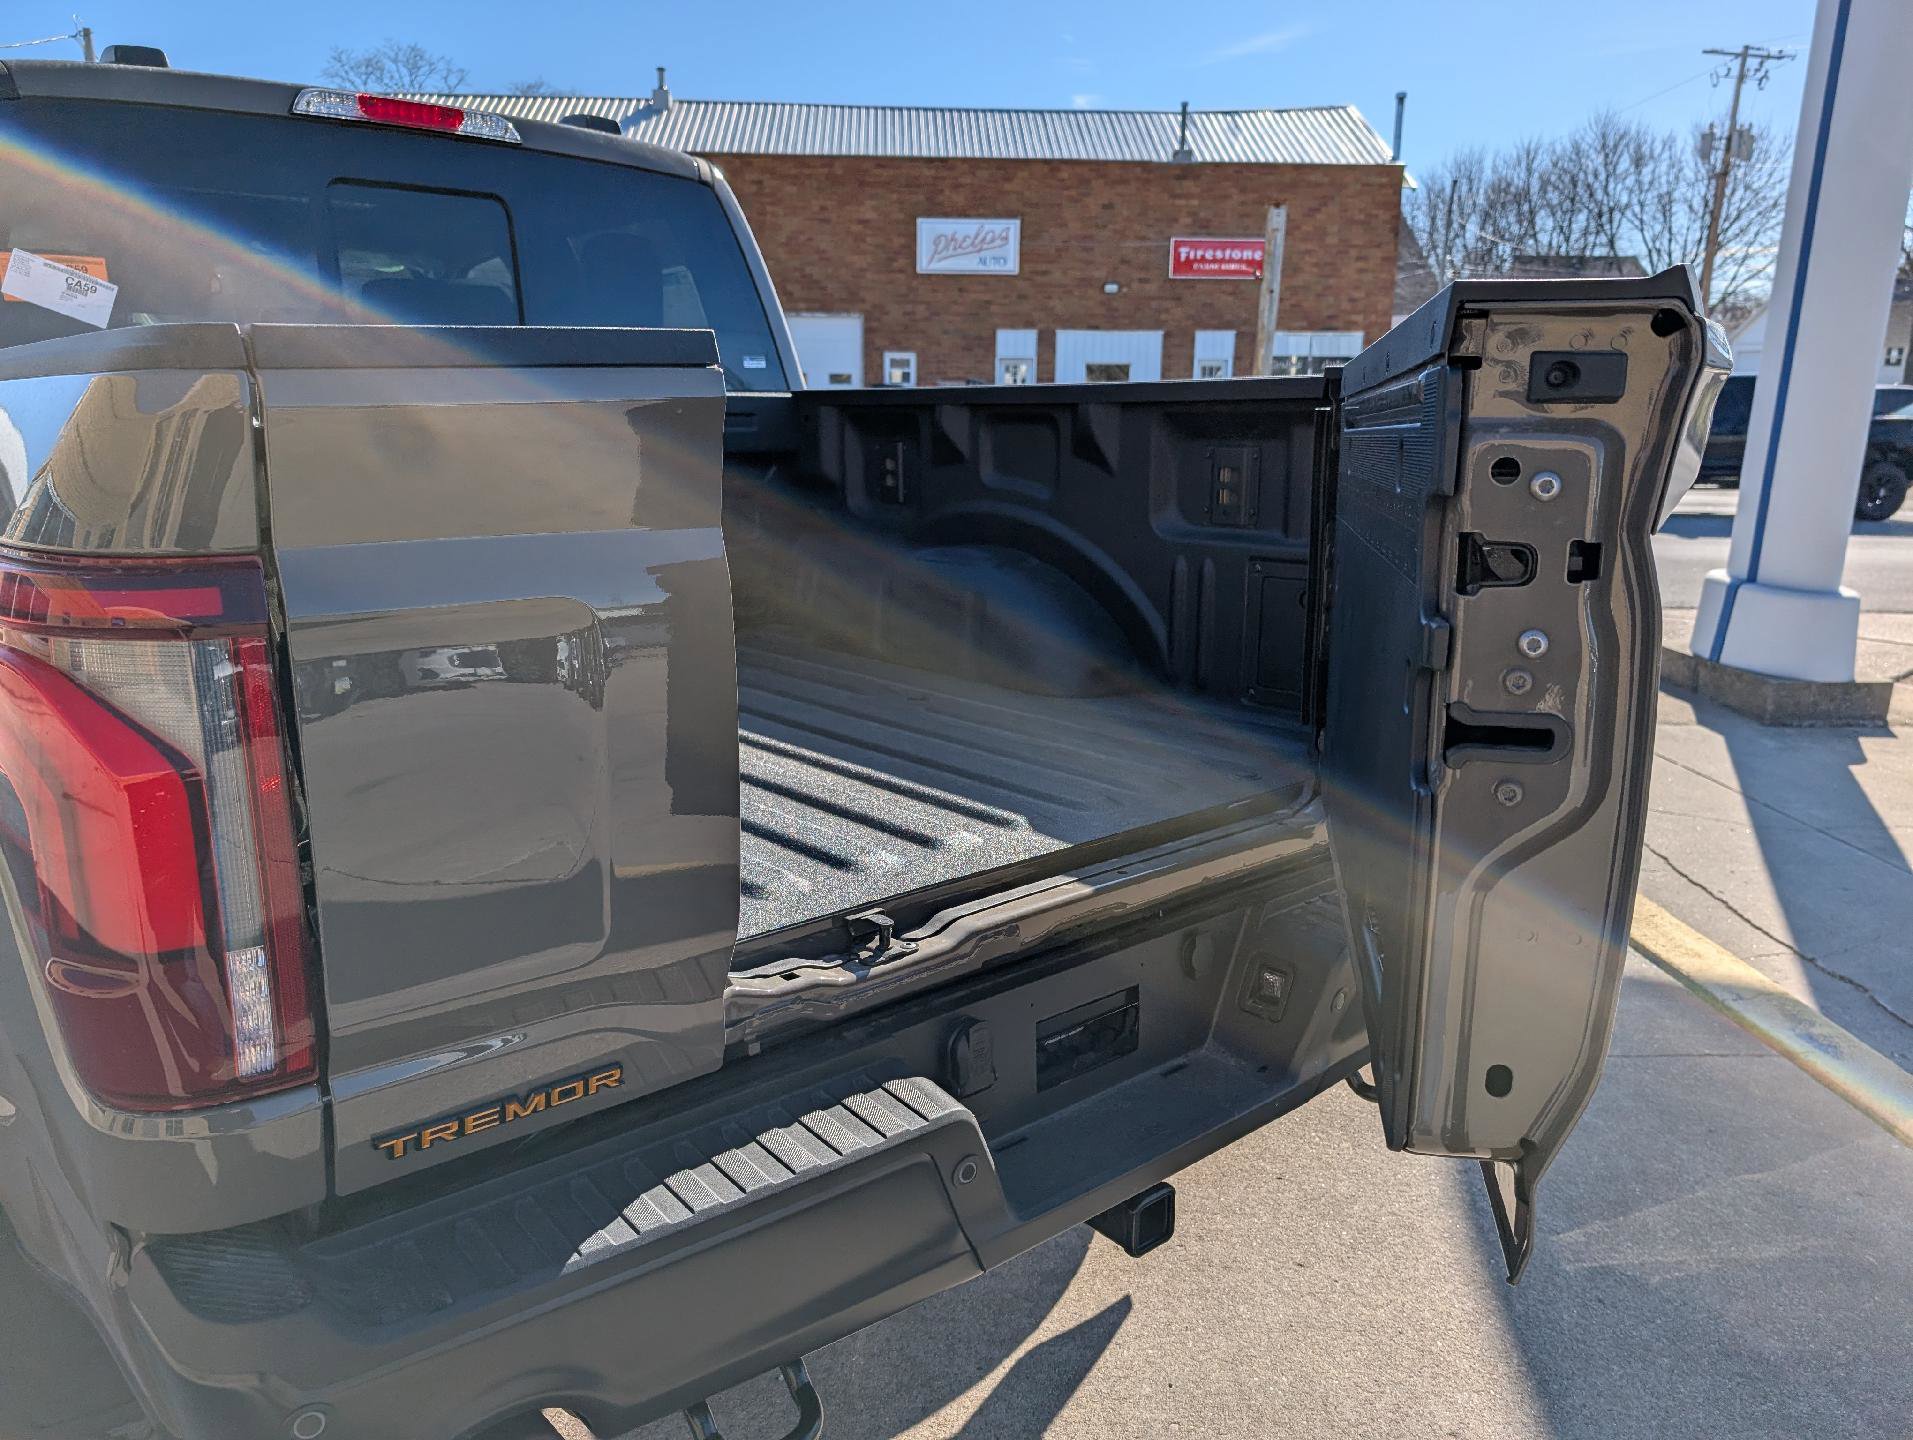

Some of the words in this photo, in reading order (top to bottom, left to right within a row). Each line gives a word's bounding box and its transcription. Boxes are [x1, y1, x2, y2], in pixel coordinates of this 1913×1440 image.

[927, 225, 1011, 267] Phelps
[1178, 246, 1264, 262] Firestone
[65, 276, 98, 294] CA59
[377, 1066, 624, 1159] TREMOR
